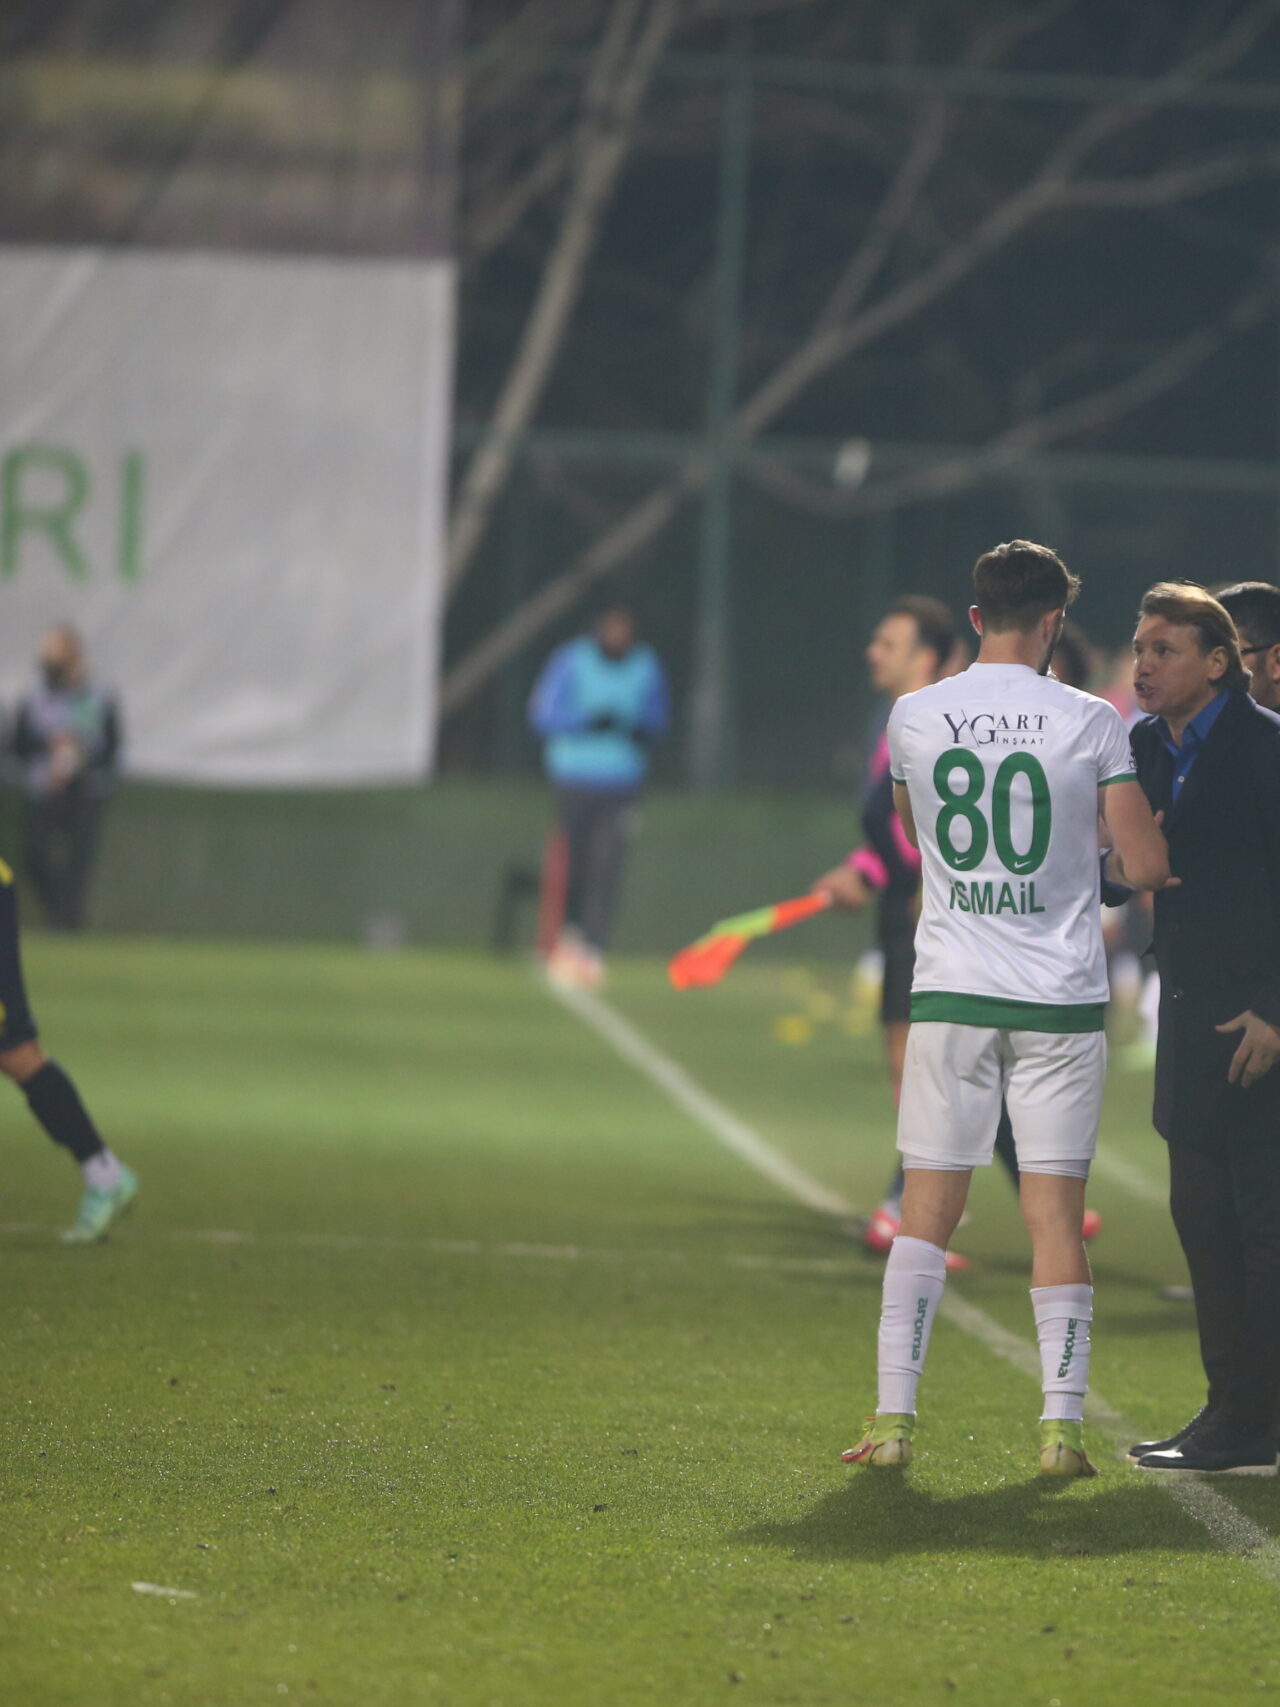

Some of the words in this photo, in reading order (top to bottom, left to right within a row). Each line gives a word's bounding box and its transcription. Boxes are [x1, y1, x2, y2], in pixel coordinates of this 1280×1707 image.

[996, 714, 1048, 730] ART
[933, 748, 1052, 875] 80
[911, 1297, 929, 1361] aroma
[1057, 1318, 1078, 1378] aroma
